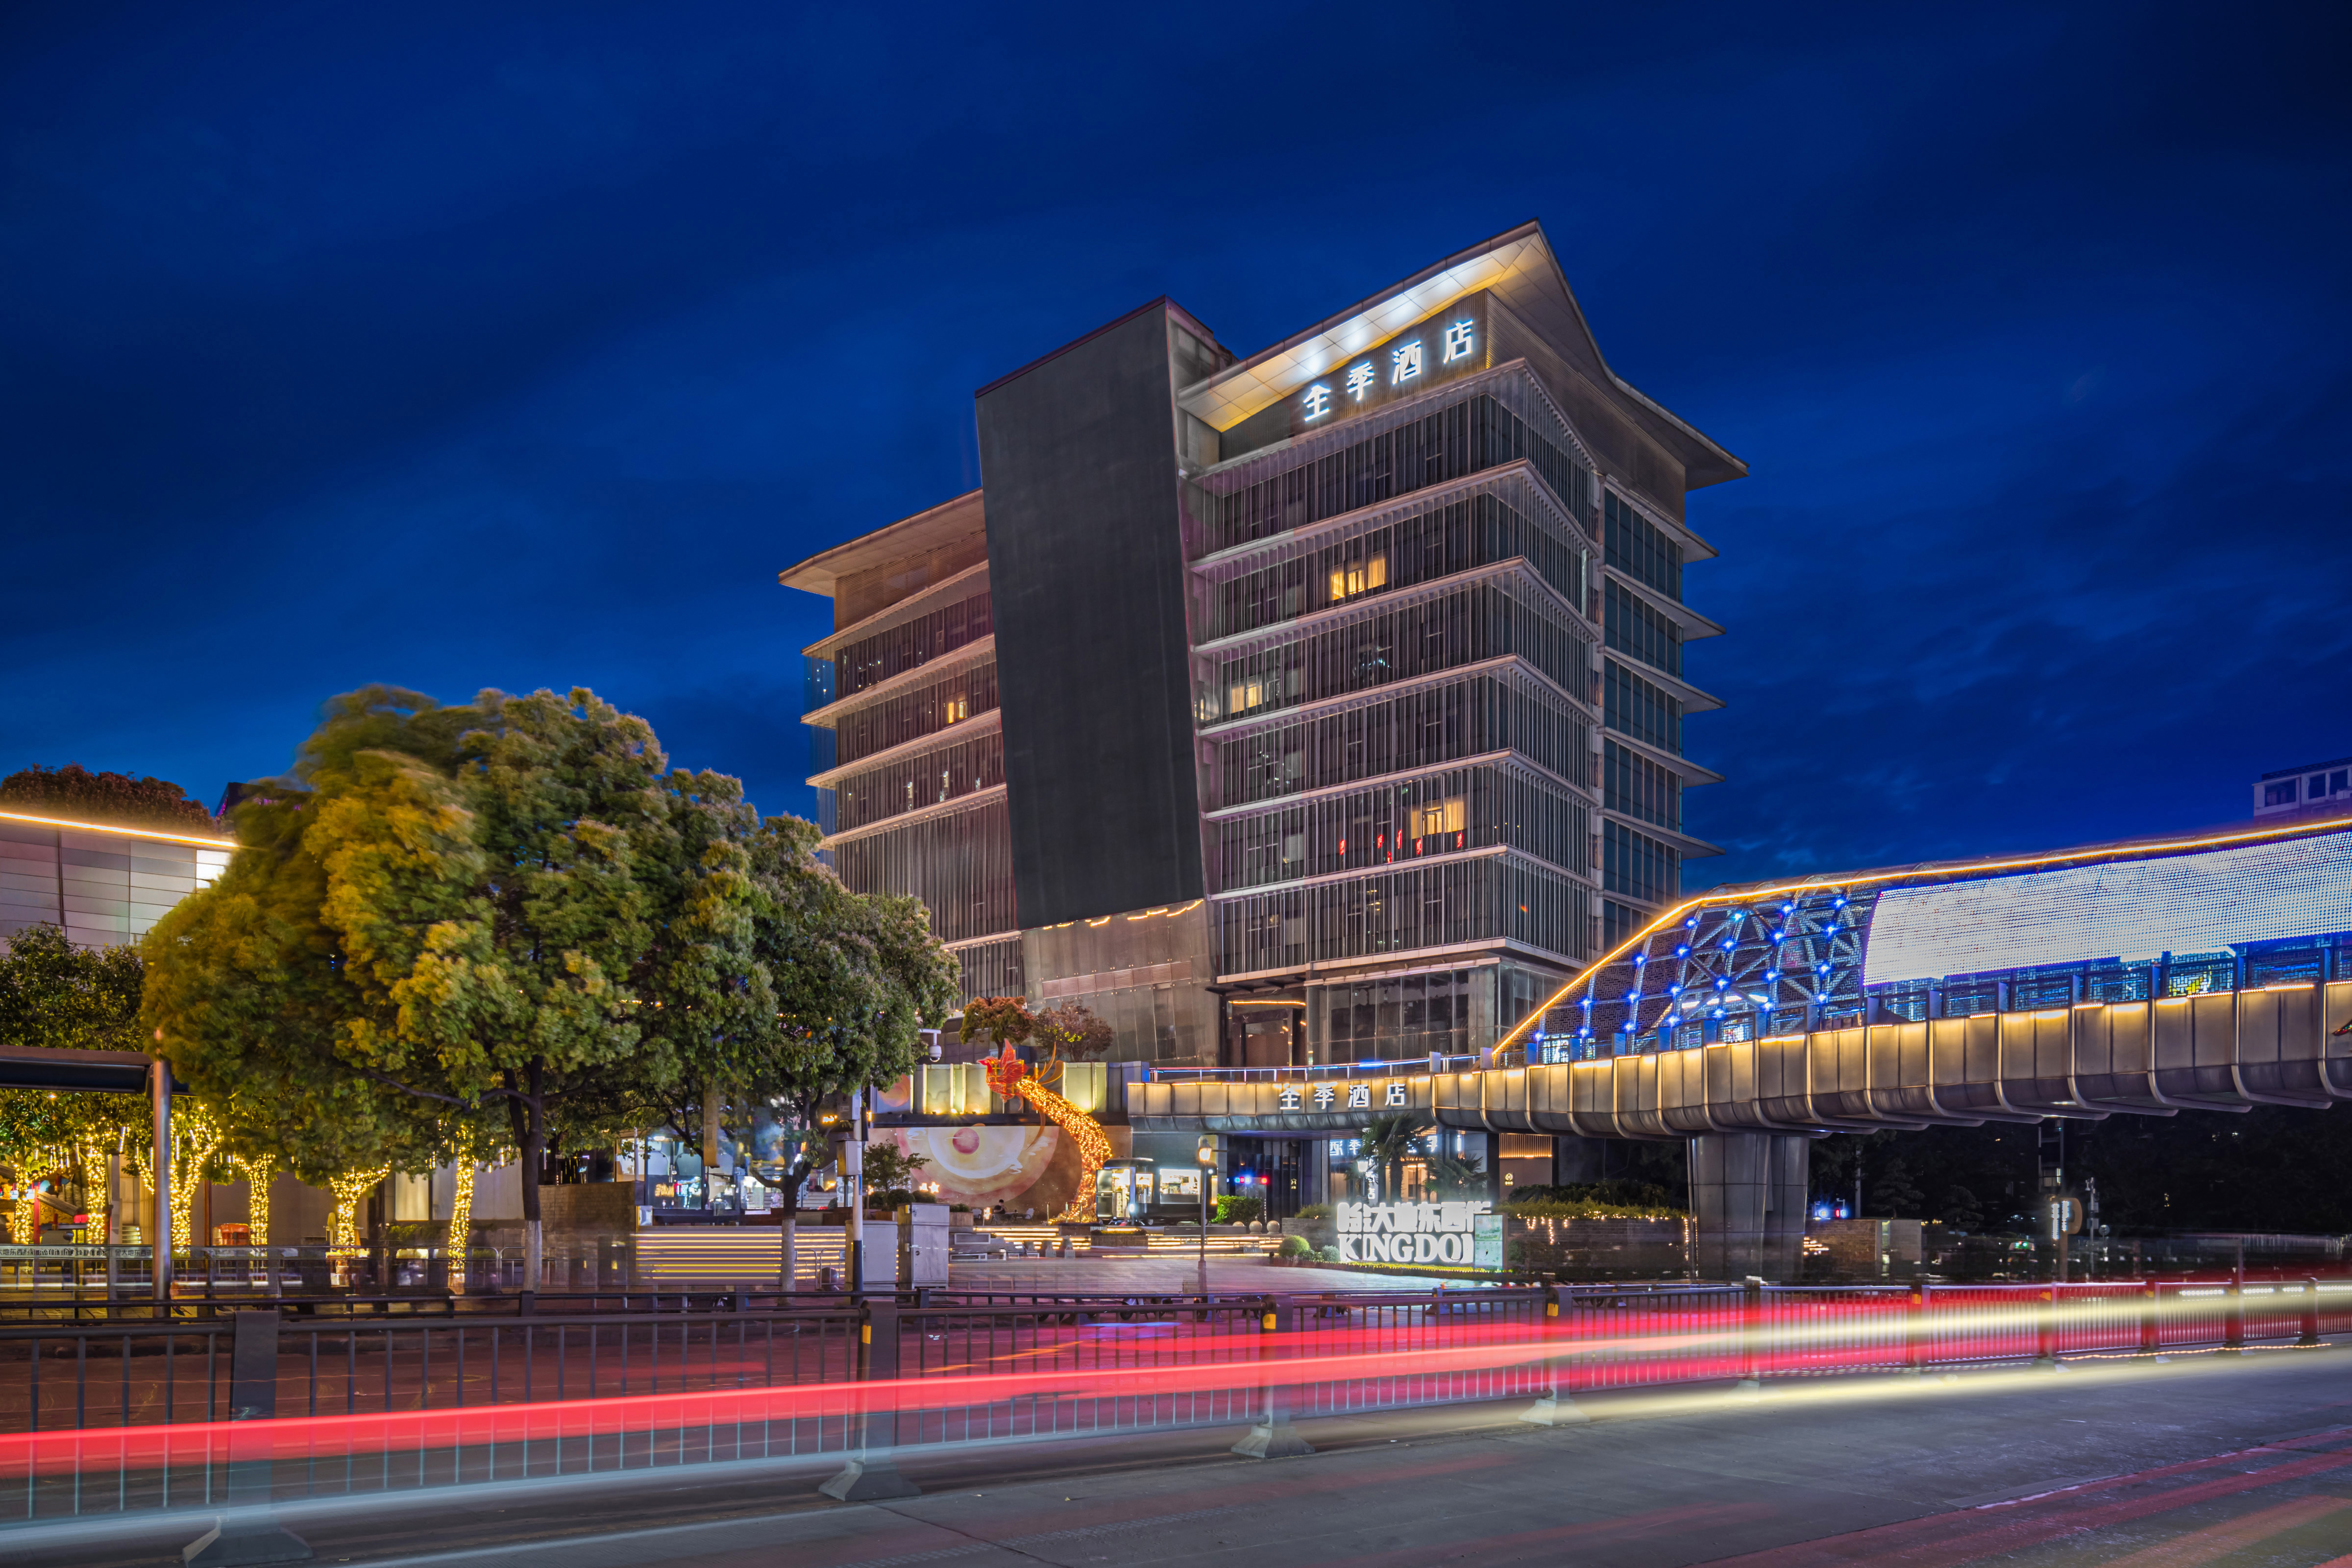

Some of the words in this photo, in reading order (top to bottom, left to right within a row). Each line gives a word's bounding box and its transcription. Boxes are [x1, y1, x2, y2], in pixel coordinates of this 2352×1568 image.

[1303, 320, 1473, 421] 全季酒店
[1279, 1082, 1405, 1109] 全季酒店
